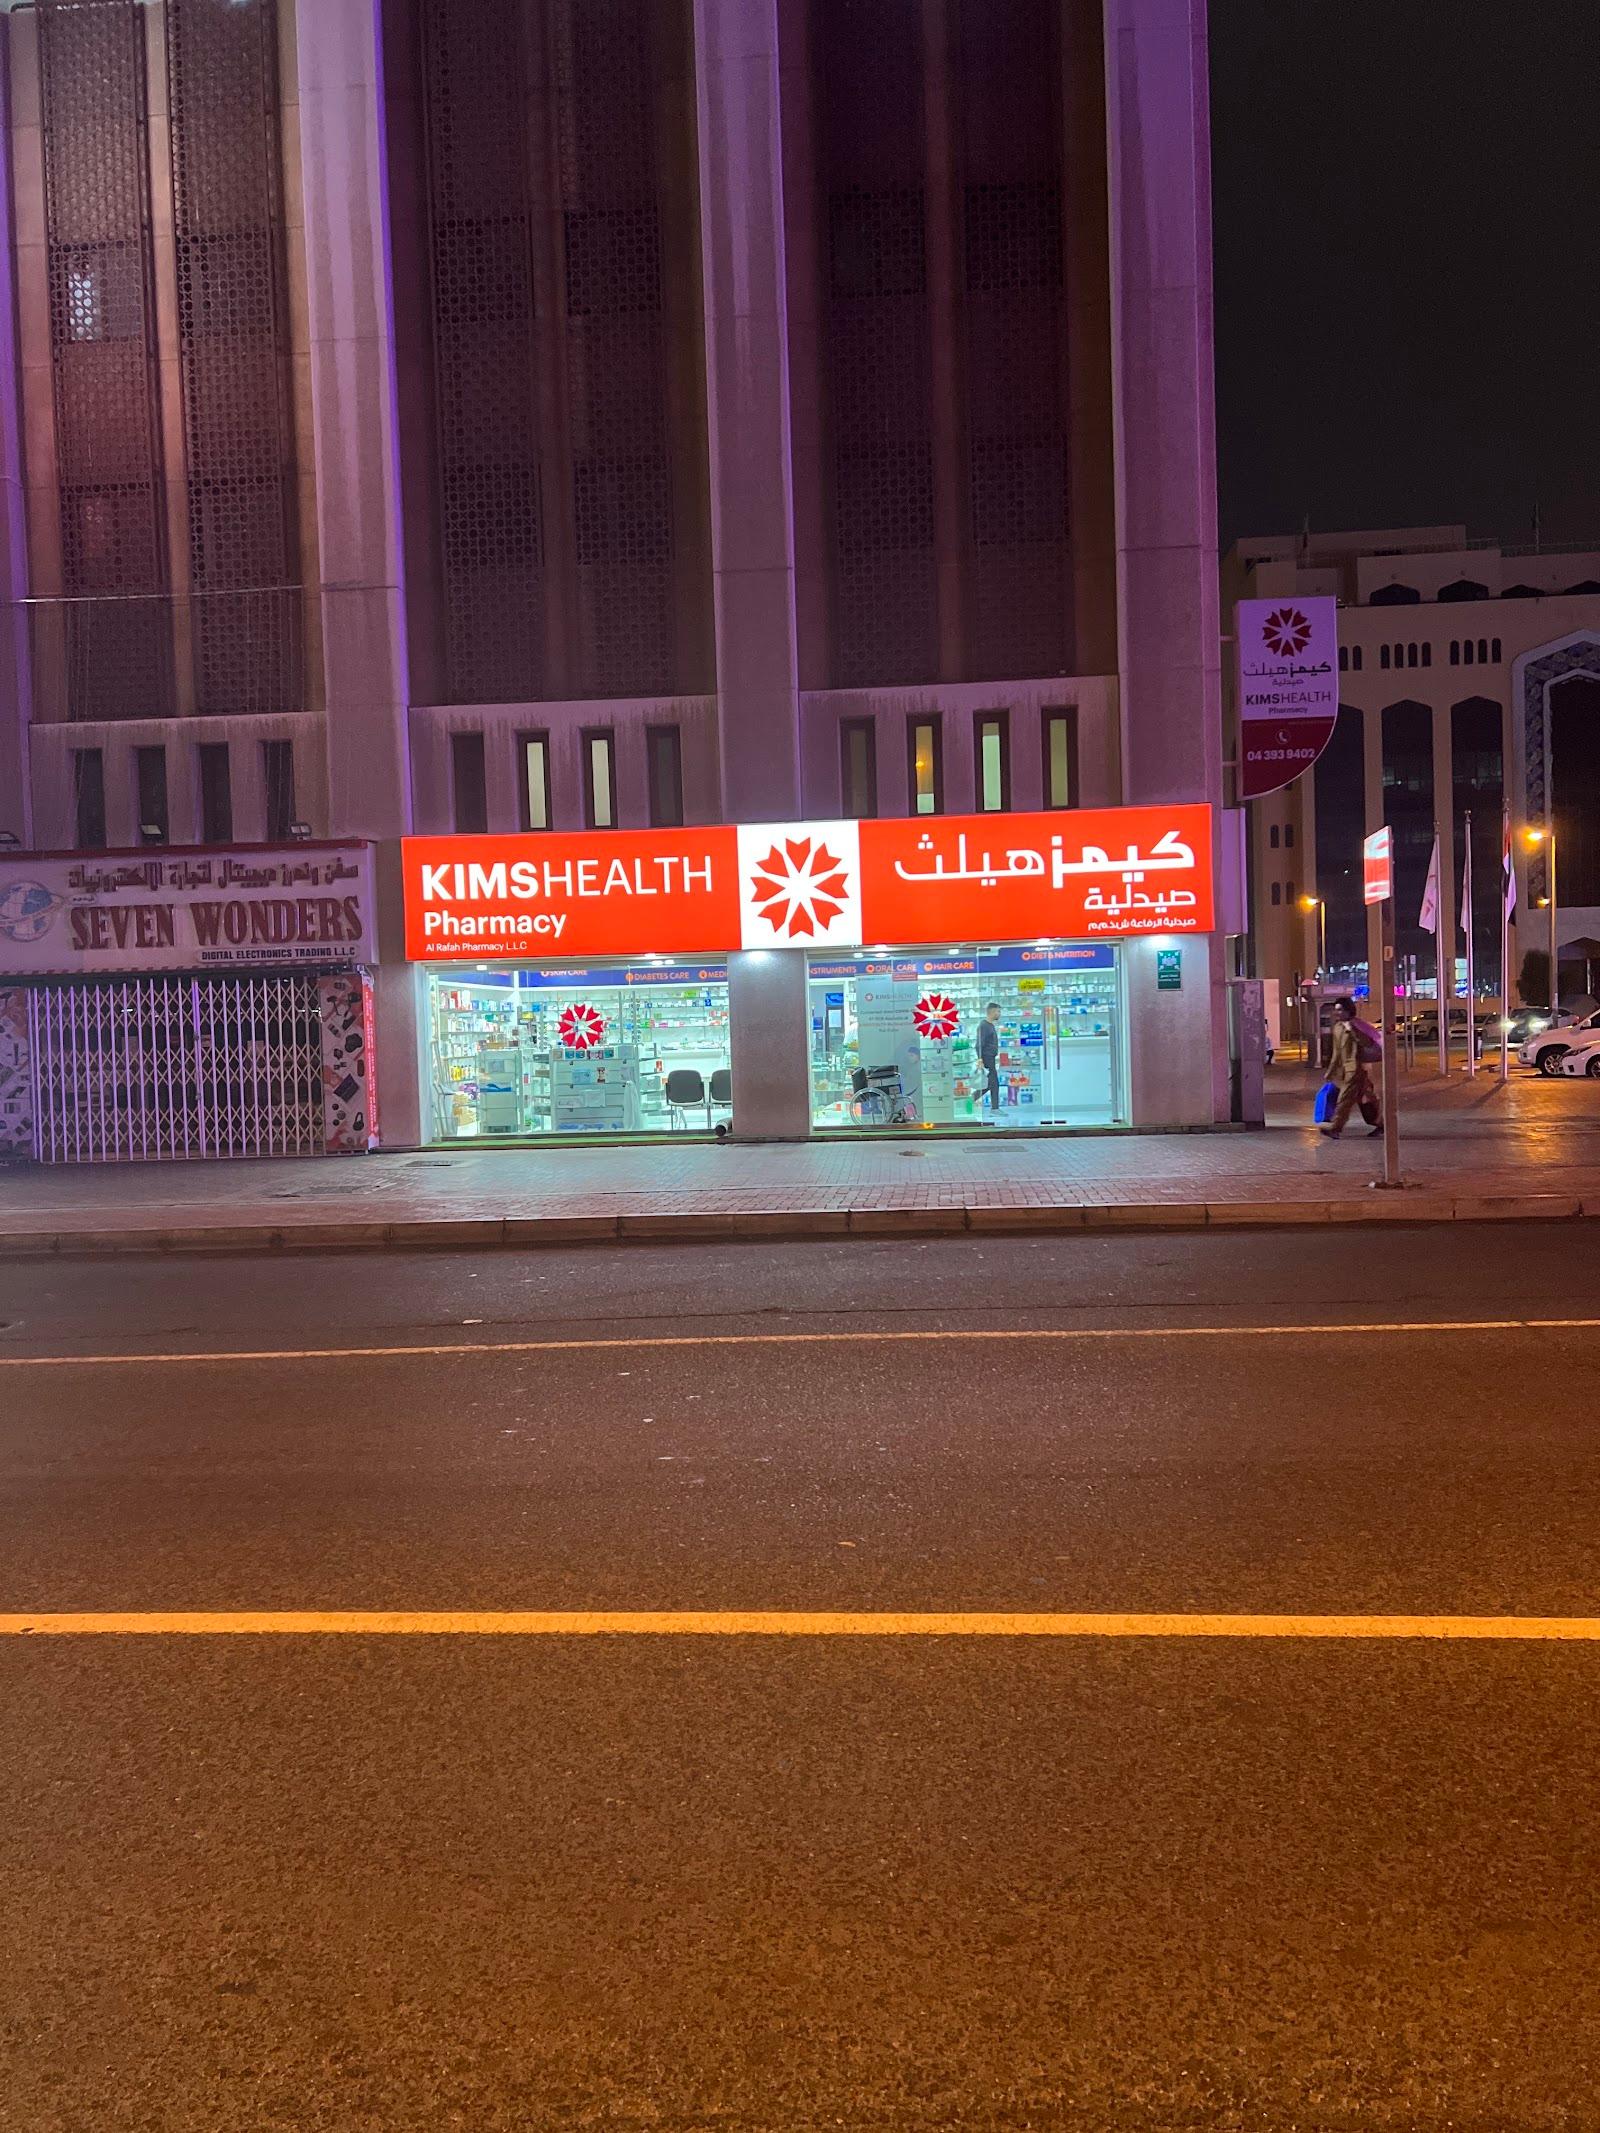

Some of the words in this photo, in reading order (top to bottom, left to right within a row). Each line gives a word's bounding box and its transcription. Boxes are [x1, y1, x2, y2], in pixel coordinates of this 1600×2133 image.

[1246, 691, 1331, 705] KIMSHEALTH
[1268, 706, 1308, 715] Pharmacy
[1247, 750, 1262, 761] 04
[421, 855, 712, 901] KIMSHEALTH
[1084, 883, 1196, 916] صيدلية
[70, 903, 175, 950] SEVEN
[189, 895, 363, 946] WONDERS
[424, 910, 567, 939] Pharmacy
[1130, 918, 1163, 928] الرفاعة
[1163, 917, 1197, 928] صيدلية
[426, 943, 435, 952] Al
[436, 942, 461, 952] Rafah
[462, 941, 504, 952] Pharmacy
[201, 950, 233, 960] DIGITAL
[236, 949, 292, 959] ELECTRONICS
[295, 947, 331, 957] TRADING
[1054, 949, 1096, 959] NUTRITION
[874, 964, 895, 973] ORAL
[896, 963, 917, 972] CARE
[933, 962, 952, 970] HAIR
[953, 961, 974, 970] CARE
[634, 972, 668, 981] DIABETES
[669, 971, 690, 980] CARE
